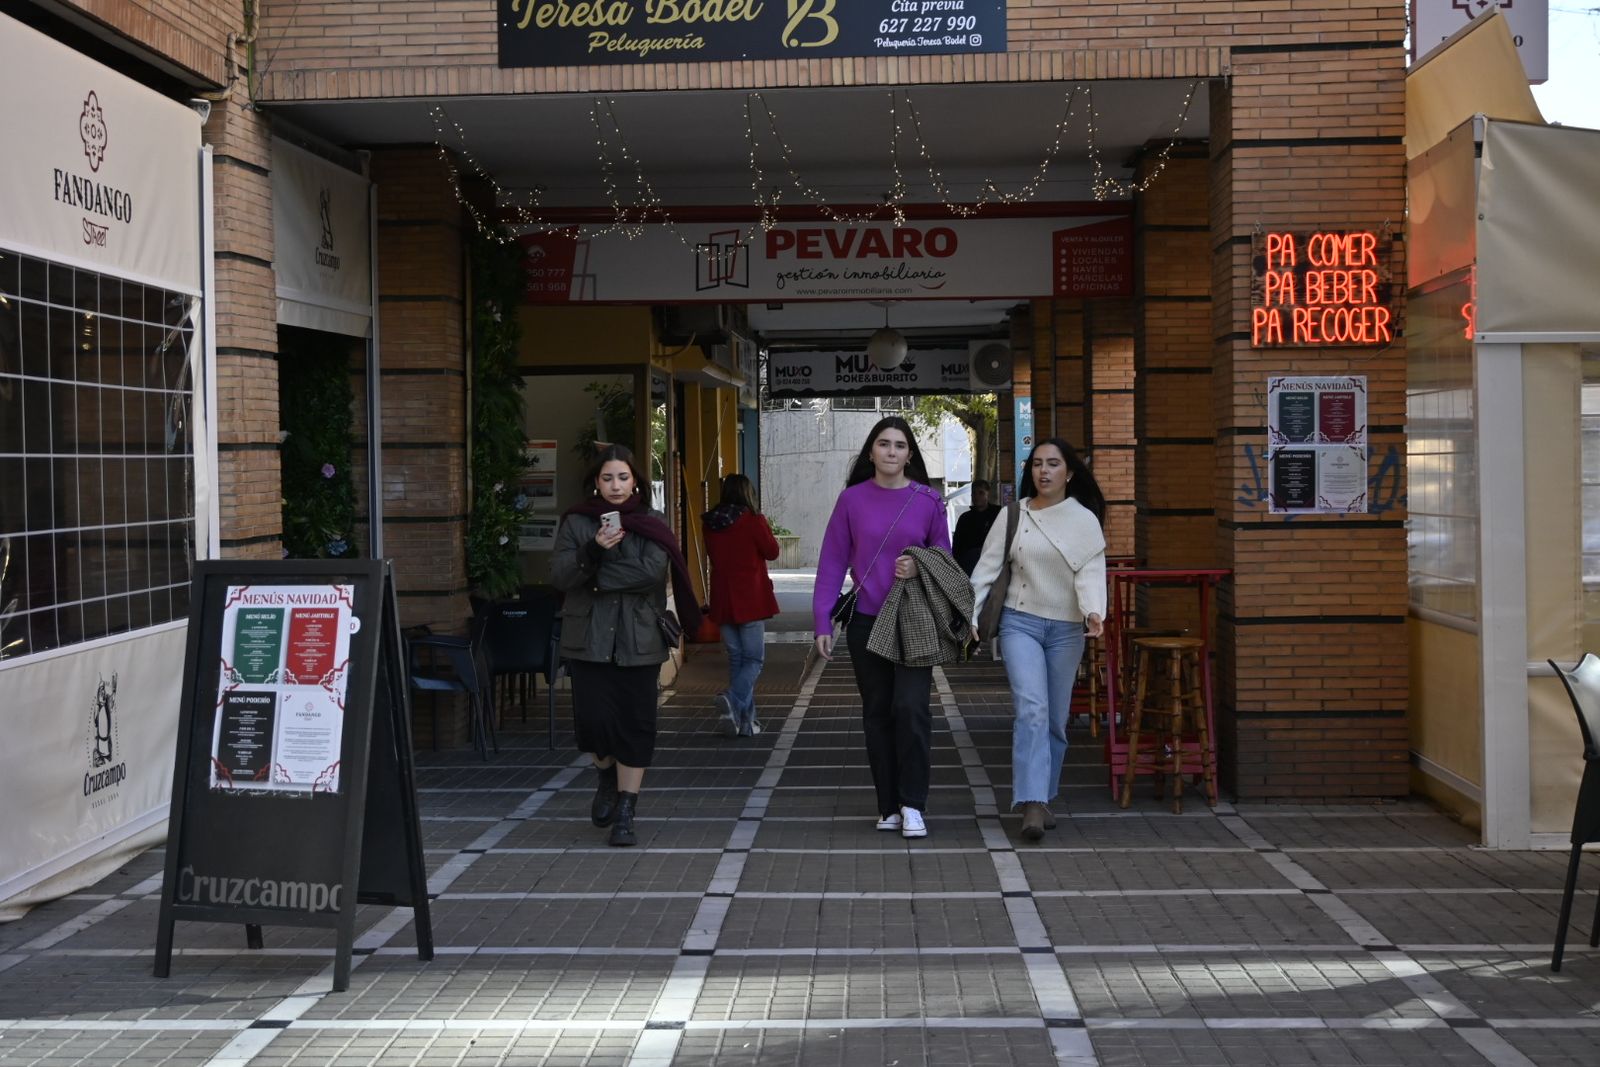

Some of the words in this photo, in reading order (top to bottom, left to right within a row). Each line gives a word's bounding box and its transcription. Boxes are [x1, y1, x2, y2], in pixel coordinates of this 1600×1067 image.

[511, 0, 634, 29] Teresa
[645, 0, 763, 23] Bodel
[891, 0, 918, 12] Cita
[921, 0, 964, 14] previa
[879, 18, 908, 33] 627
[912, 17, 942, 32] 227
[946, 16, 976, 31] 990
[588, 31, 706, 57] Peluquería
[54, 168, 132, 224] FANDANGO
[766, 227, 958, 259] PEVARO
[1072, 247, 1124, 256] VIVIENDAS
[1266, 233, 1296, 269] PA
[1308, 232, 1377, 267] COMER
[1072, 257, 1117, 265] LOCALES
[1072, 265, 1104, 273] NAVES
[776, 267, 840, 289] gestión
[843, 262, 947, 280] inmobiliaria
[1072, 282, 1120, 291] OFICINAS
[1265, 271, 1295, 307] PA
[1306, 269, 1378, 305] BEBER
[1253, 308, 1283, 346] PA
[1293, 306, 1390, 344] RECOGER
[775, 365, 812, 378] MUXO
[836, 354, 896, 373] MU
[836, 373, 918, 384] POKE&BURRITO
[1281, 381, 1313, 391] MENÚS
[1315, 382, 1353, 391] NAVIDAD
[242, 591, 284, 605] MENÚS
[286, 593, 338, 605] NAVIDAD
[84, 762, 126, 797] Cruzcampo
